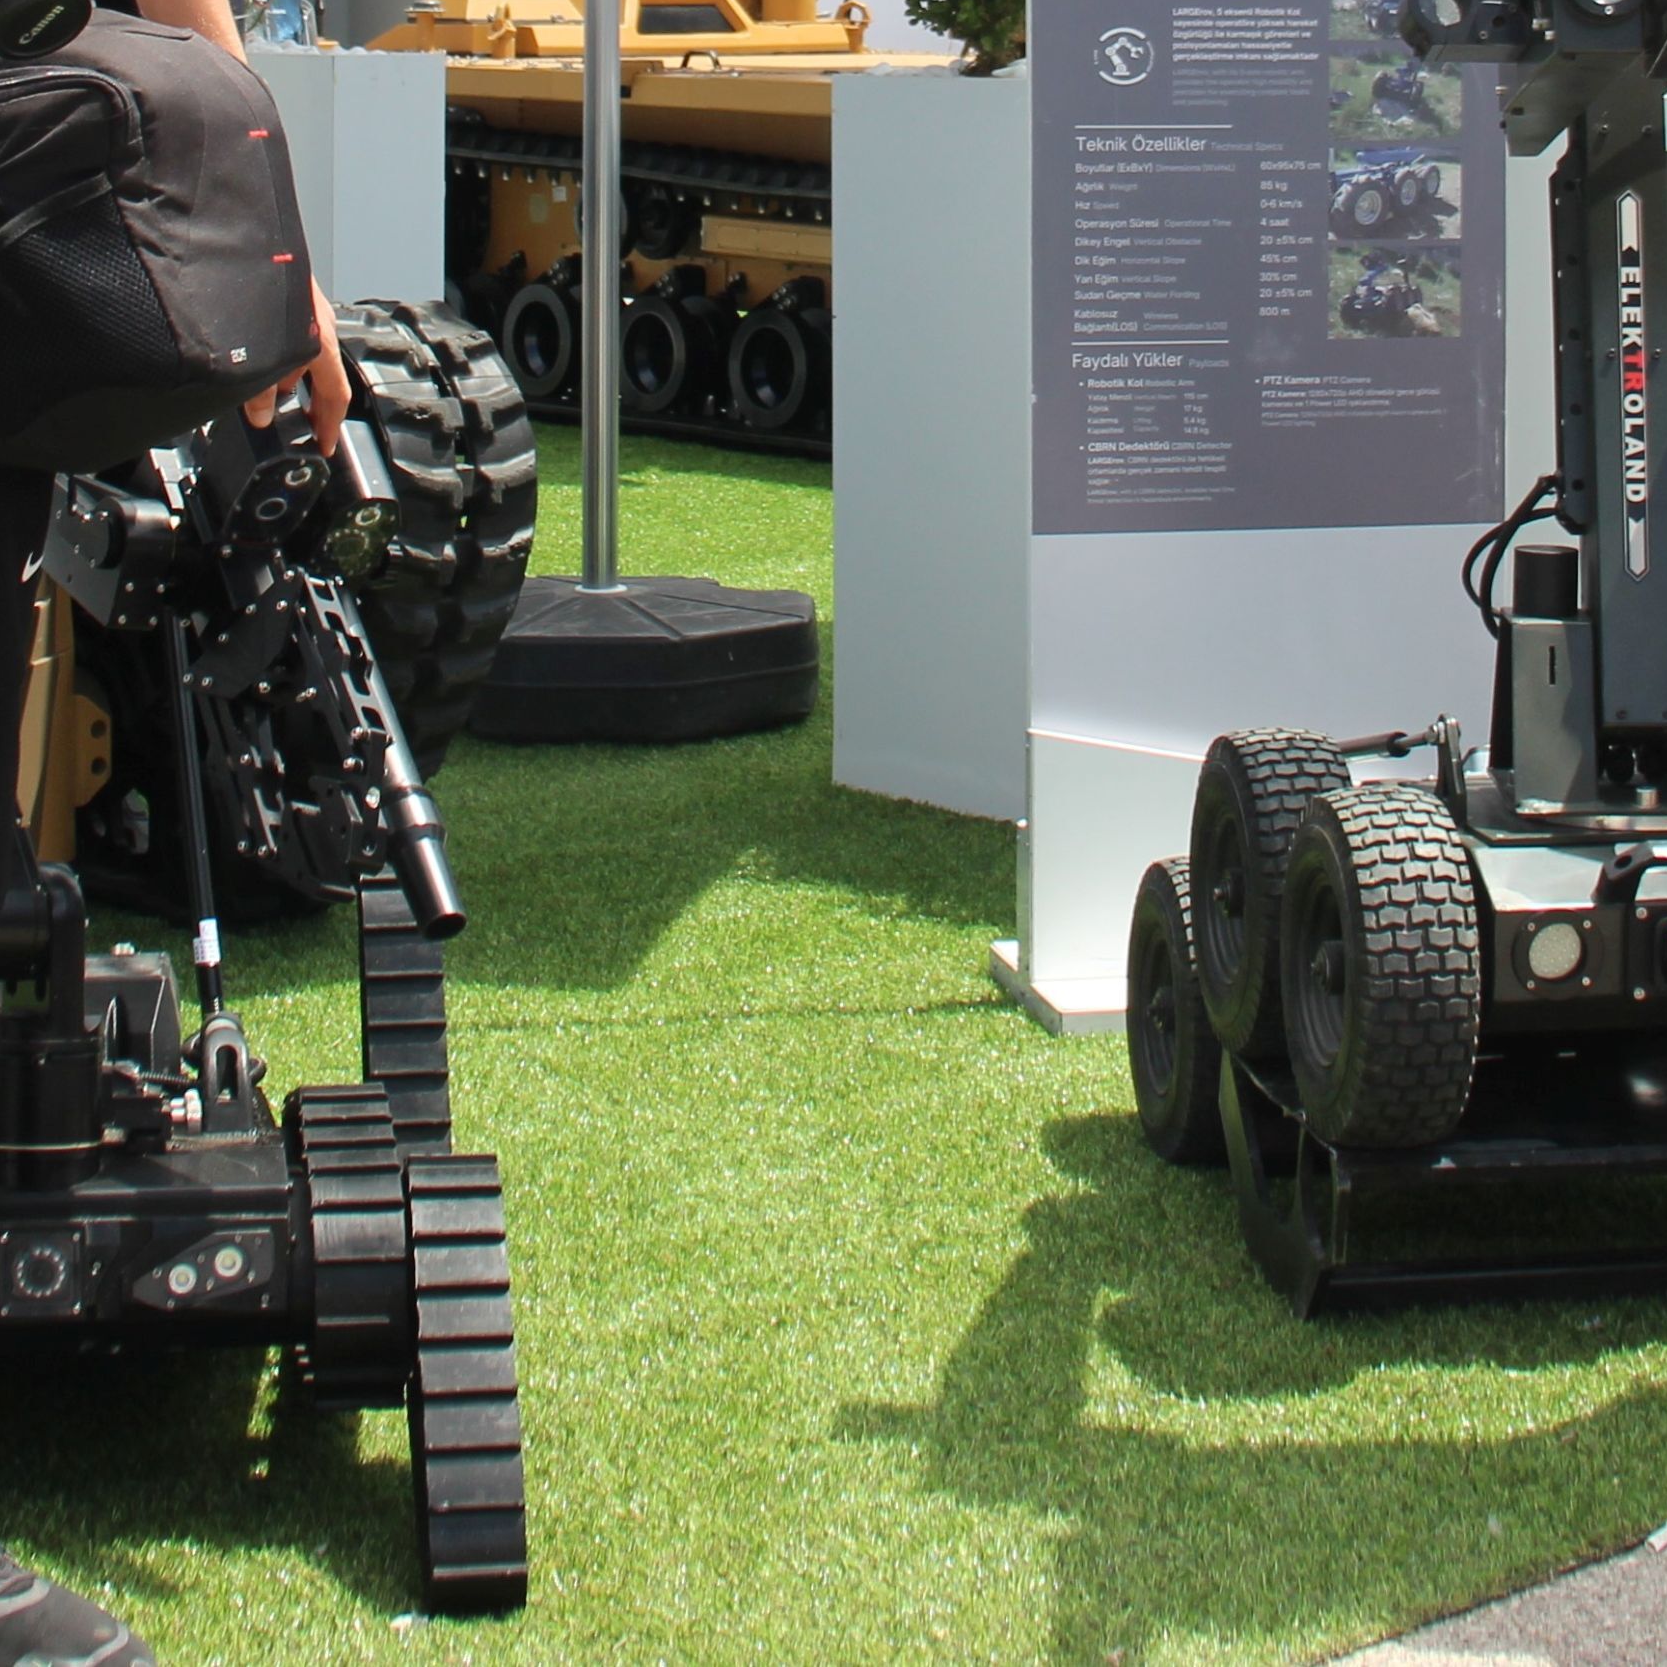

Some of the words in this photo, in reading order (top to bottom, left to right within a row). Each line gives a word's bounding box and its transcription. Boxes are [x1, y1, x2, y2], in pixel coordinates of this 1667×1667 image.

[19, 5, 65, 44] Canon
[1076, 136, 1127, 152] Teknik
[1132, 135, 1206, 152] Özellikler
[1075, 163, 1115, 173] Boyutlar
[1276, 181, 1287, 191] kg
[1075, 201, 1090, 209] Hız
[1075, 219, 1127, 230] Operasyon
[1129, 218, 1158, 228] Süresi
[1260, 218, 1266, 227] 4
[1075, 237, 1101, 247] Dikey
[1104, 237, 1130, 248] Engel
[1075, 256, 1090, 265] Dik
[1092, 256, 1115, 266] Eğim
[1075, 275, 1092, 283] Yan
[1095, 274, 1118, 285] Eğim
[1075, 291, 1104, 300] Sudan
[1107, 291, 1141, 301] Geçme
[1072, 353, 1128, 371] Faydalı
[1133, 352, 1182, 367] Yükler
[1087, 379, 1125, 388] Robotik
[1127, 379, 1143, 387] Kol
[1263, 376, 1282, 384] PTZ
[1284, 376, 1320, 384] Kamera
[1620, 266, 1647, 503] ELEKTROLAND
[1087, 442, 1116, 451] CBRN
[1118, 441, 1170, 451] Dedektörü
